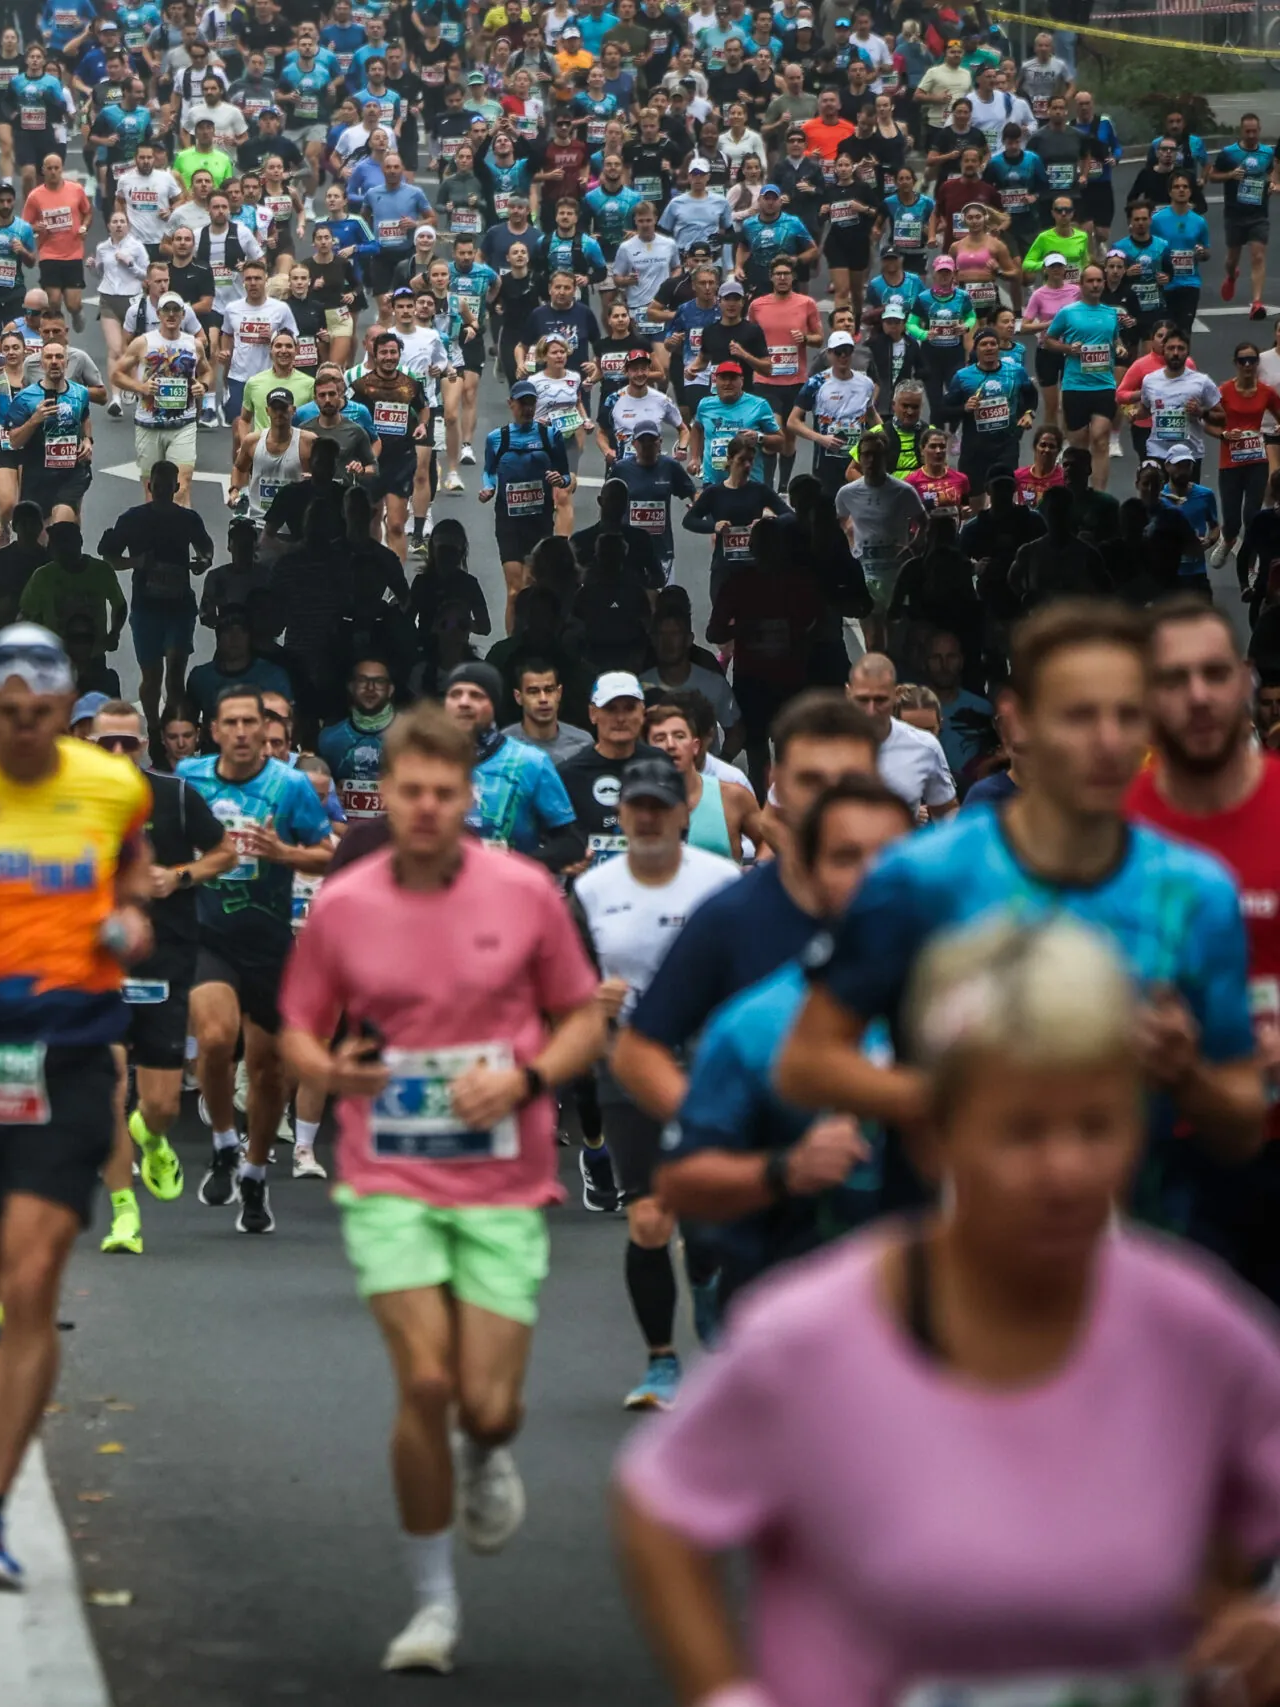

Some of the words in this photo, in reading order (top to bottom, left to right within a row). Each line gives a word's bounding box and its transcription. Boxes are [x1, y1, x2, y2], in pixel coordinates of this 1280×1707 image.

[169, 385, 186, 396] 1635
[388, 411, 407, 422] 8735
[645, 510, 664, 521] 7428
[728, 533, 750, 547] C147
